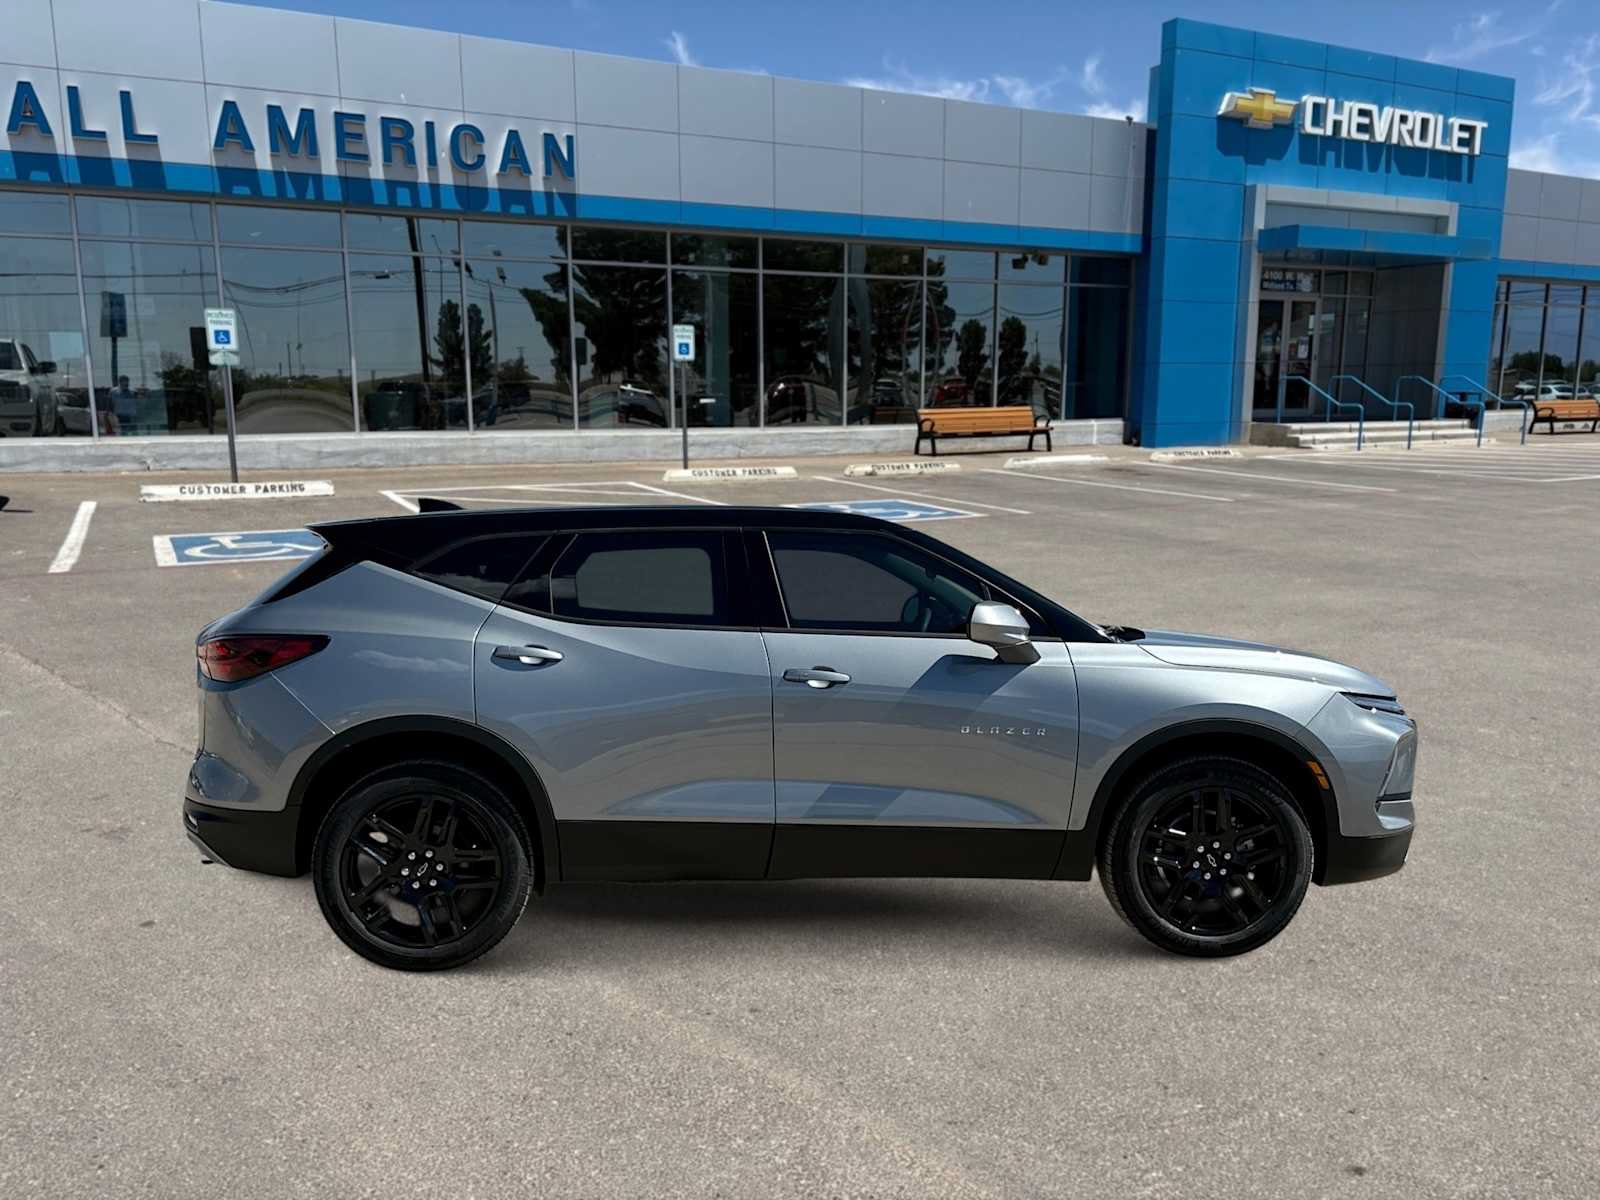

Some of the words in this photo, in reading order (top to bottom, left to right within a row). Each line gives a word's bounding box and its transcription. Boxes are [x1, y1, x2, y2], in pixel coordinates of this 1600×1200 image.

[6, 80, 158, 144] ALL
[213, 100, 575, 179] AMERICAN
[1302, 94, 1488, 155] CHEVROLET
[691, 469, 737, 477] CUSTOMER
[742, 468, 778, 476] PARKING
[179, 486, 247, 495] CUSTOMER
[254, 484, 306, 494] PARKING
[960, 725, 1047, 736] BLAZER
